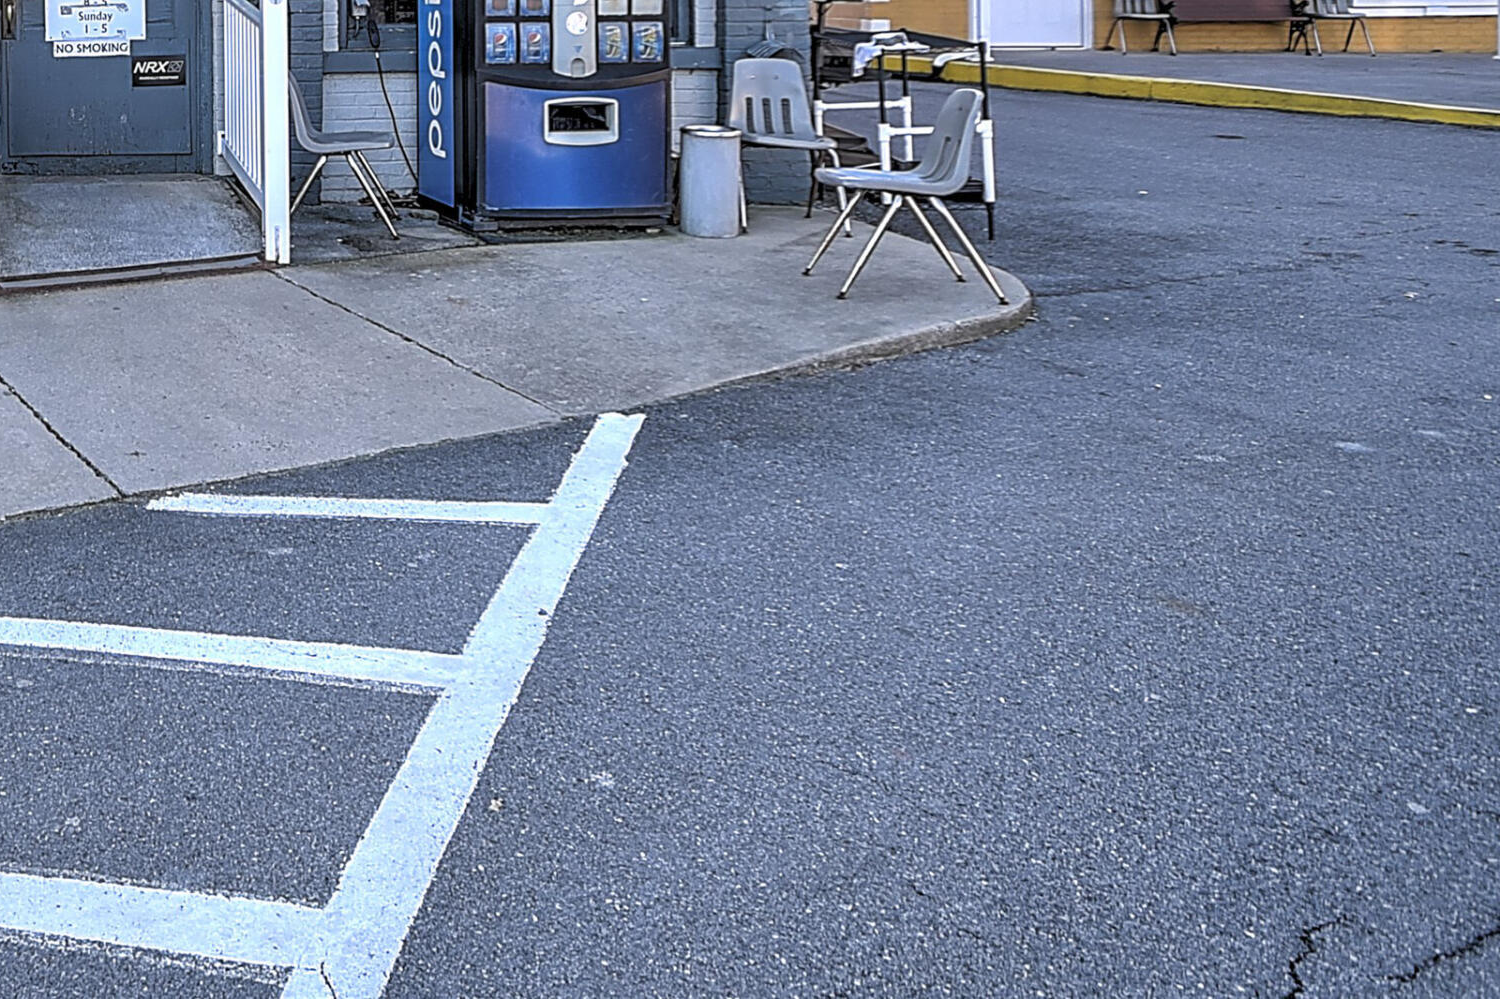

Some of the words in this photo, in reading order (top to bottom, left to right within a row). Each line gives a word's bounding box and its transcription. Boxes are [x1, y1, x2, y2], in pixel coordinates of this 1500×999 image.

[78, 11, 113, 22] Sunday
[101, 23, 108, 34] 5
[56, 44, 73, 53] NO
[76, 43, 128, 53] SMOKING
[133, 61, 169, 73] NRX
